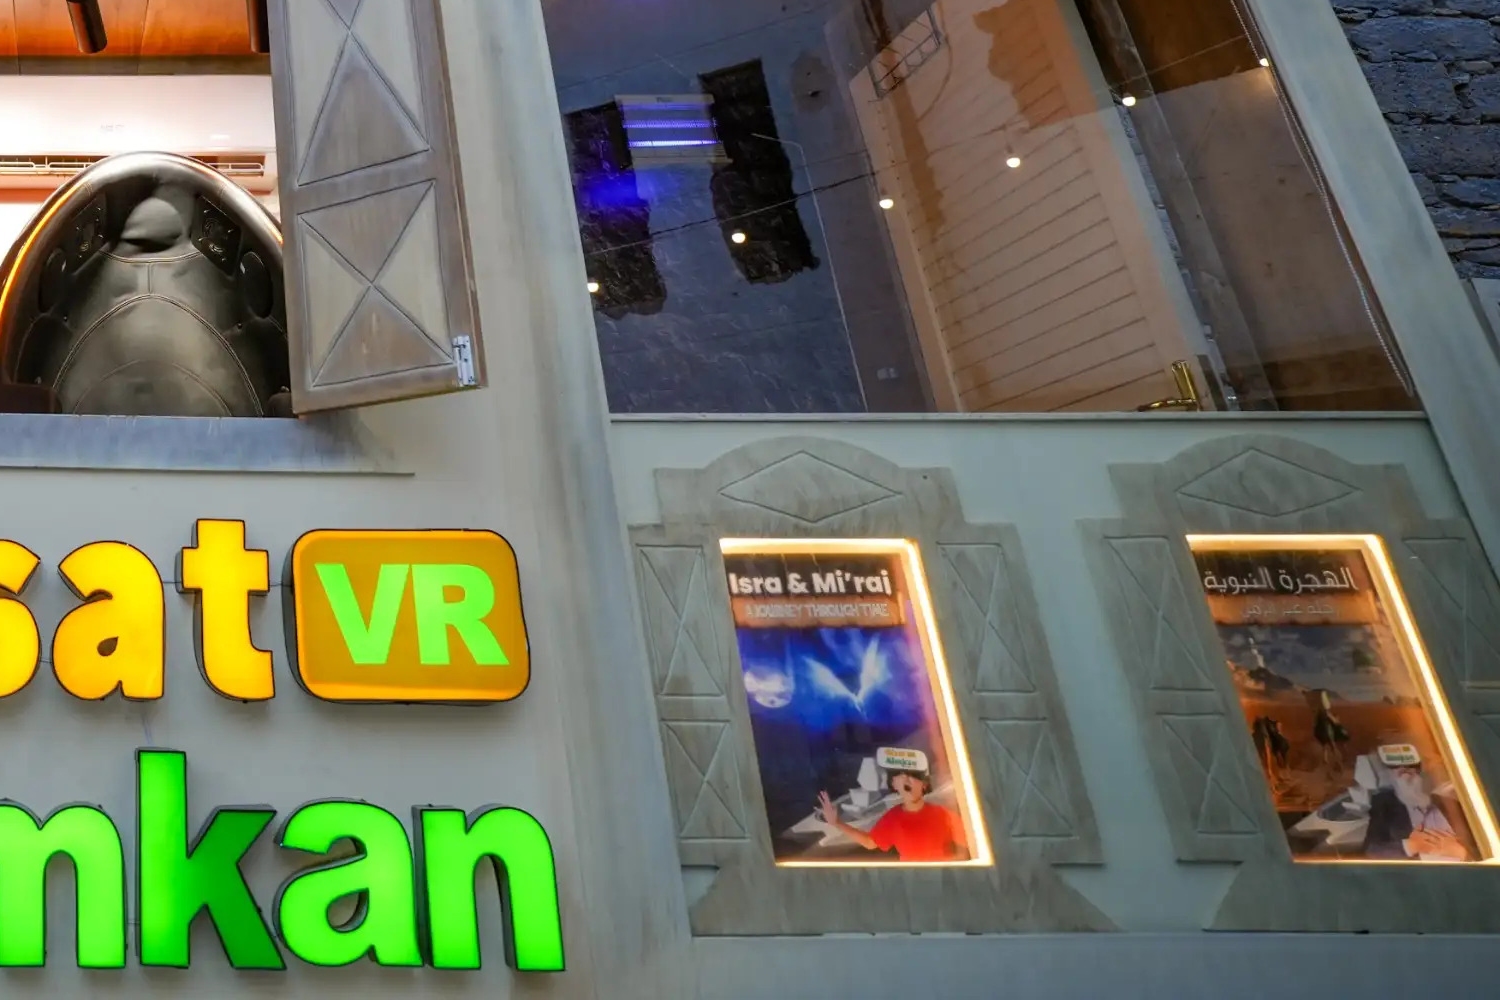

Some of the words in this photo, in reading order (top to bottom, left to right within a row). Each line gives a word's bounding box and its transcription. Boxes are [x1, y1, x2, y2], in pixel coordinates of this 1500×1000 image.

[729, 573, 783, 595] Isra
[788, 573, 810, 594] &
[1204, 567, 1275, 595] النبوية
[1278, 567, 1359, 595] الهجرة
[314, 563, 510, 665] VR
[804, 603, 858, 617] THROUGH
